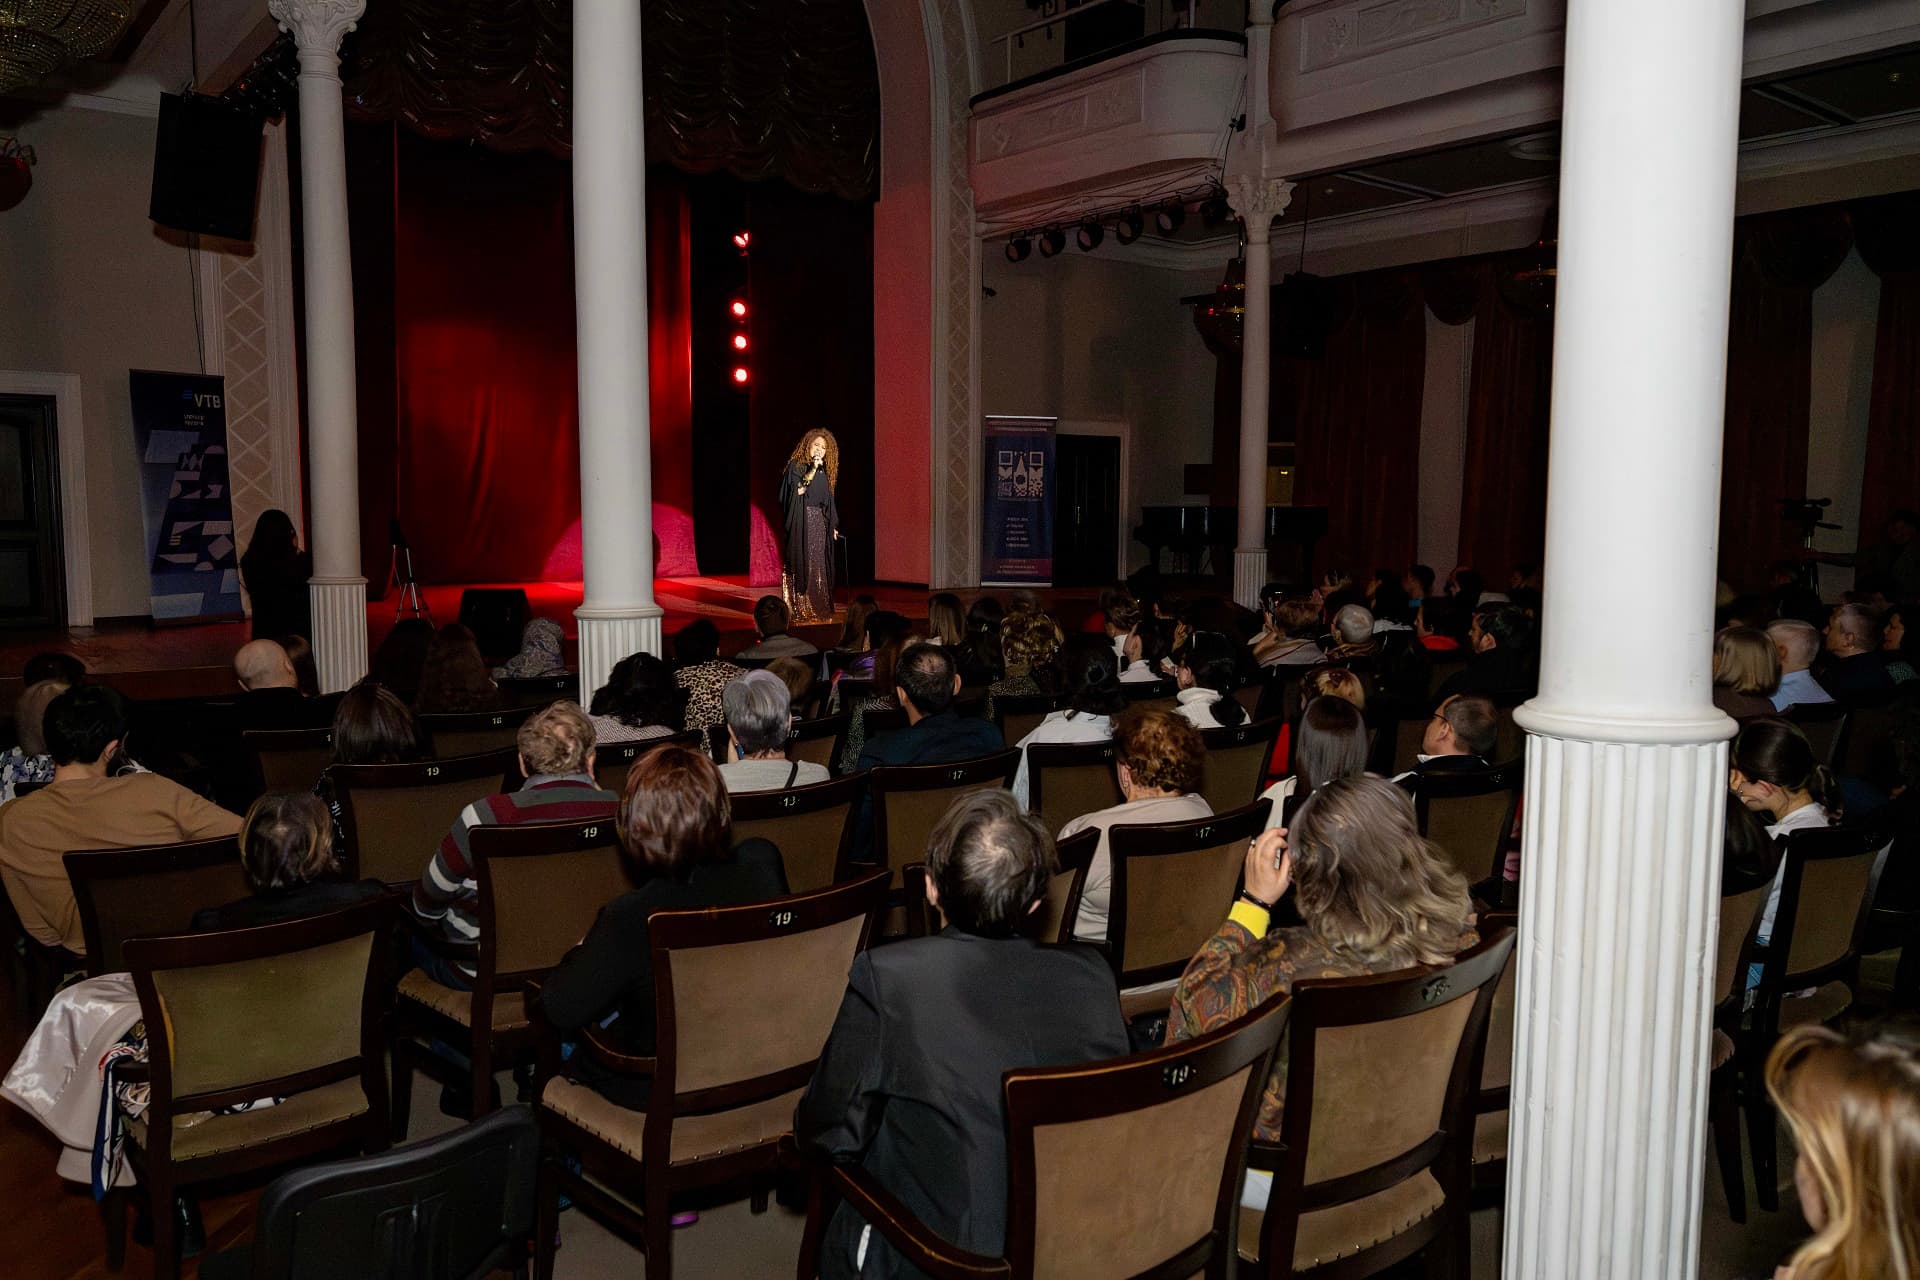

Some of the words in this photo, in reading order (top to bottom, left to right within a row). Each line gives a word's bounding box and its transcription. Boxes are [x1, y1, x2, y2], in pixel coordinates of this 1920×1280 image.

[193, 393, 221, 408] VTB
[623, 747, 634, 758] 18
[426, 766, 440, 777] 19
[583, 826, 598, 839] 19
[775, 911, 792, 927] 19
